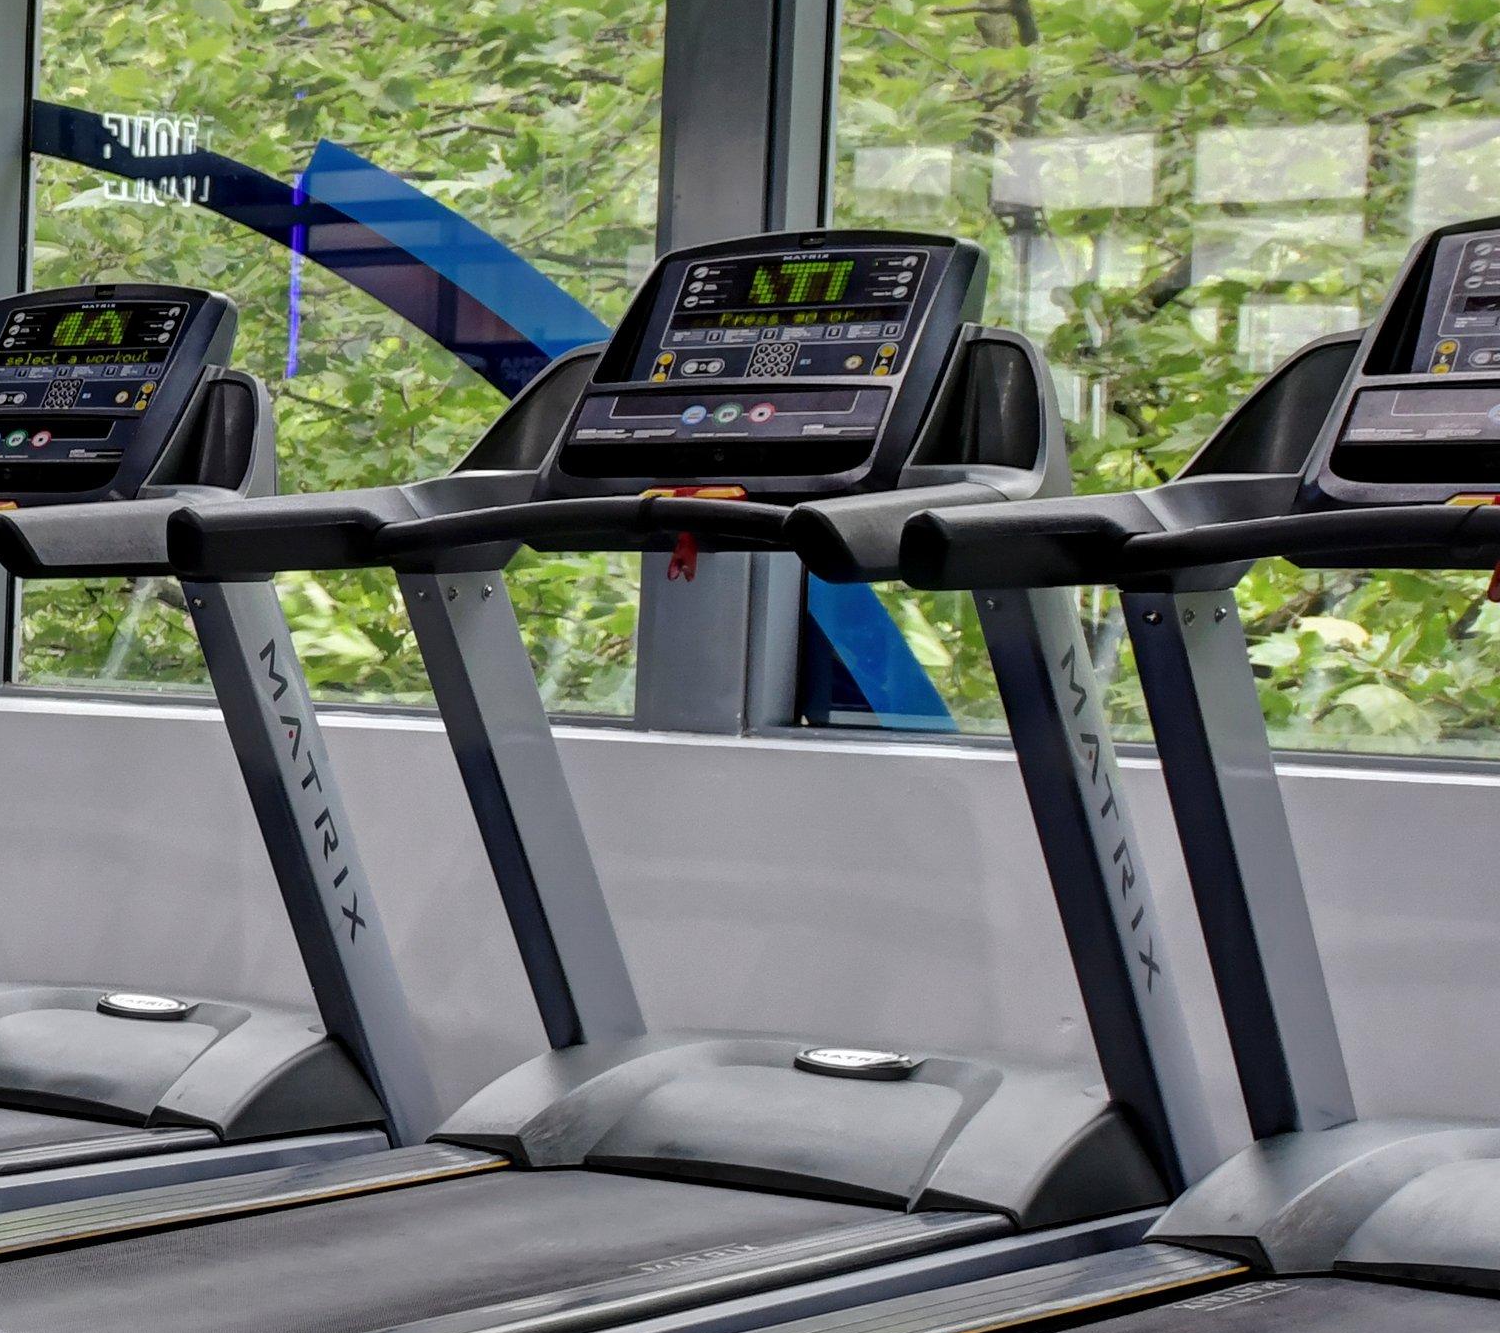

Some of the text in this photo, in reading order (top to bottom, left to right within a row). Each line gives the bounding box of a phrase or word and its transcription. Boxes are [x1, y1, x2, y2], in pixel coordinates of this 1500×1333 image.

[5, 350, 149, 365] select a workout
[259, 638, 366, 945] MATRIX
[1061, 644, 1161, 995] MATRIX
